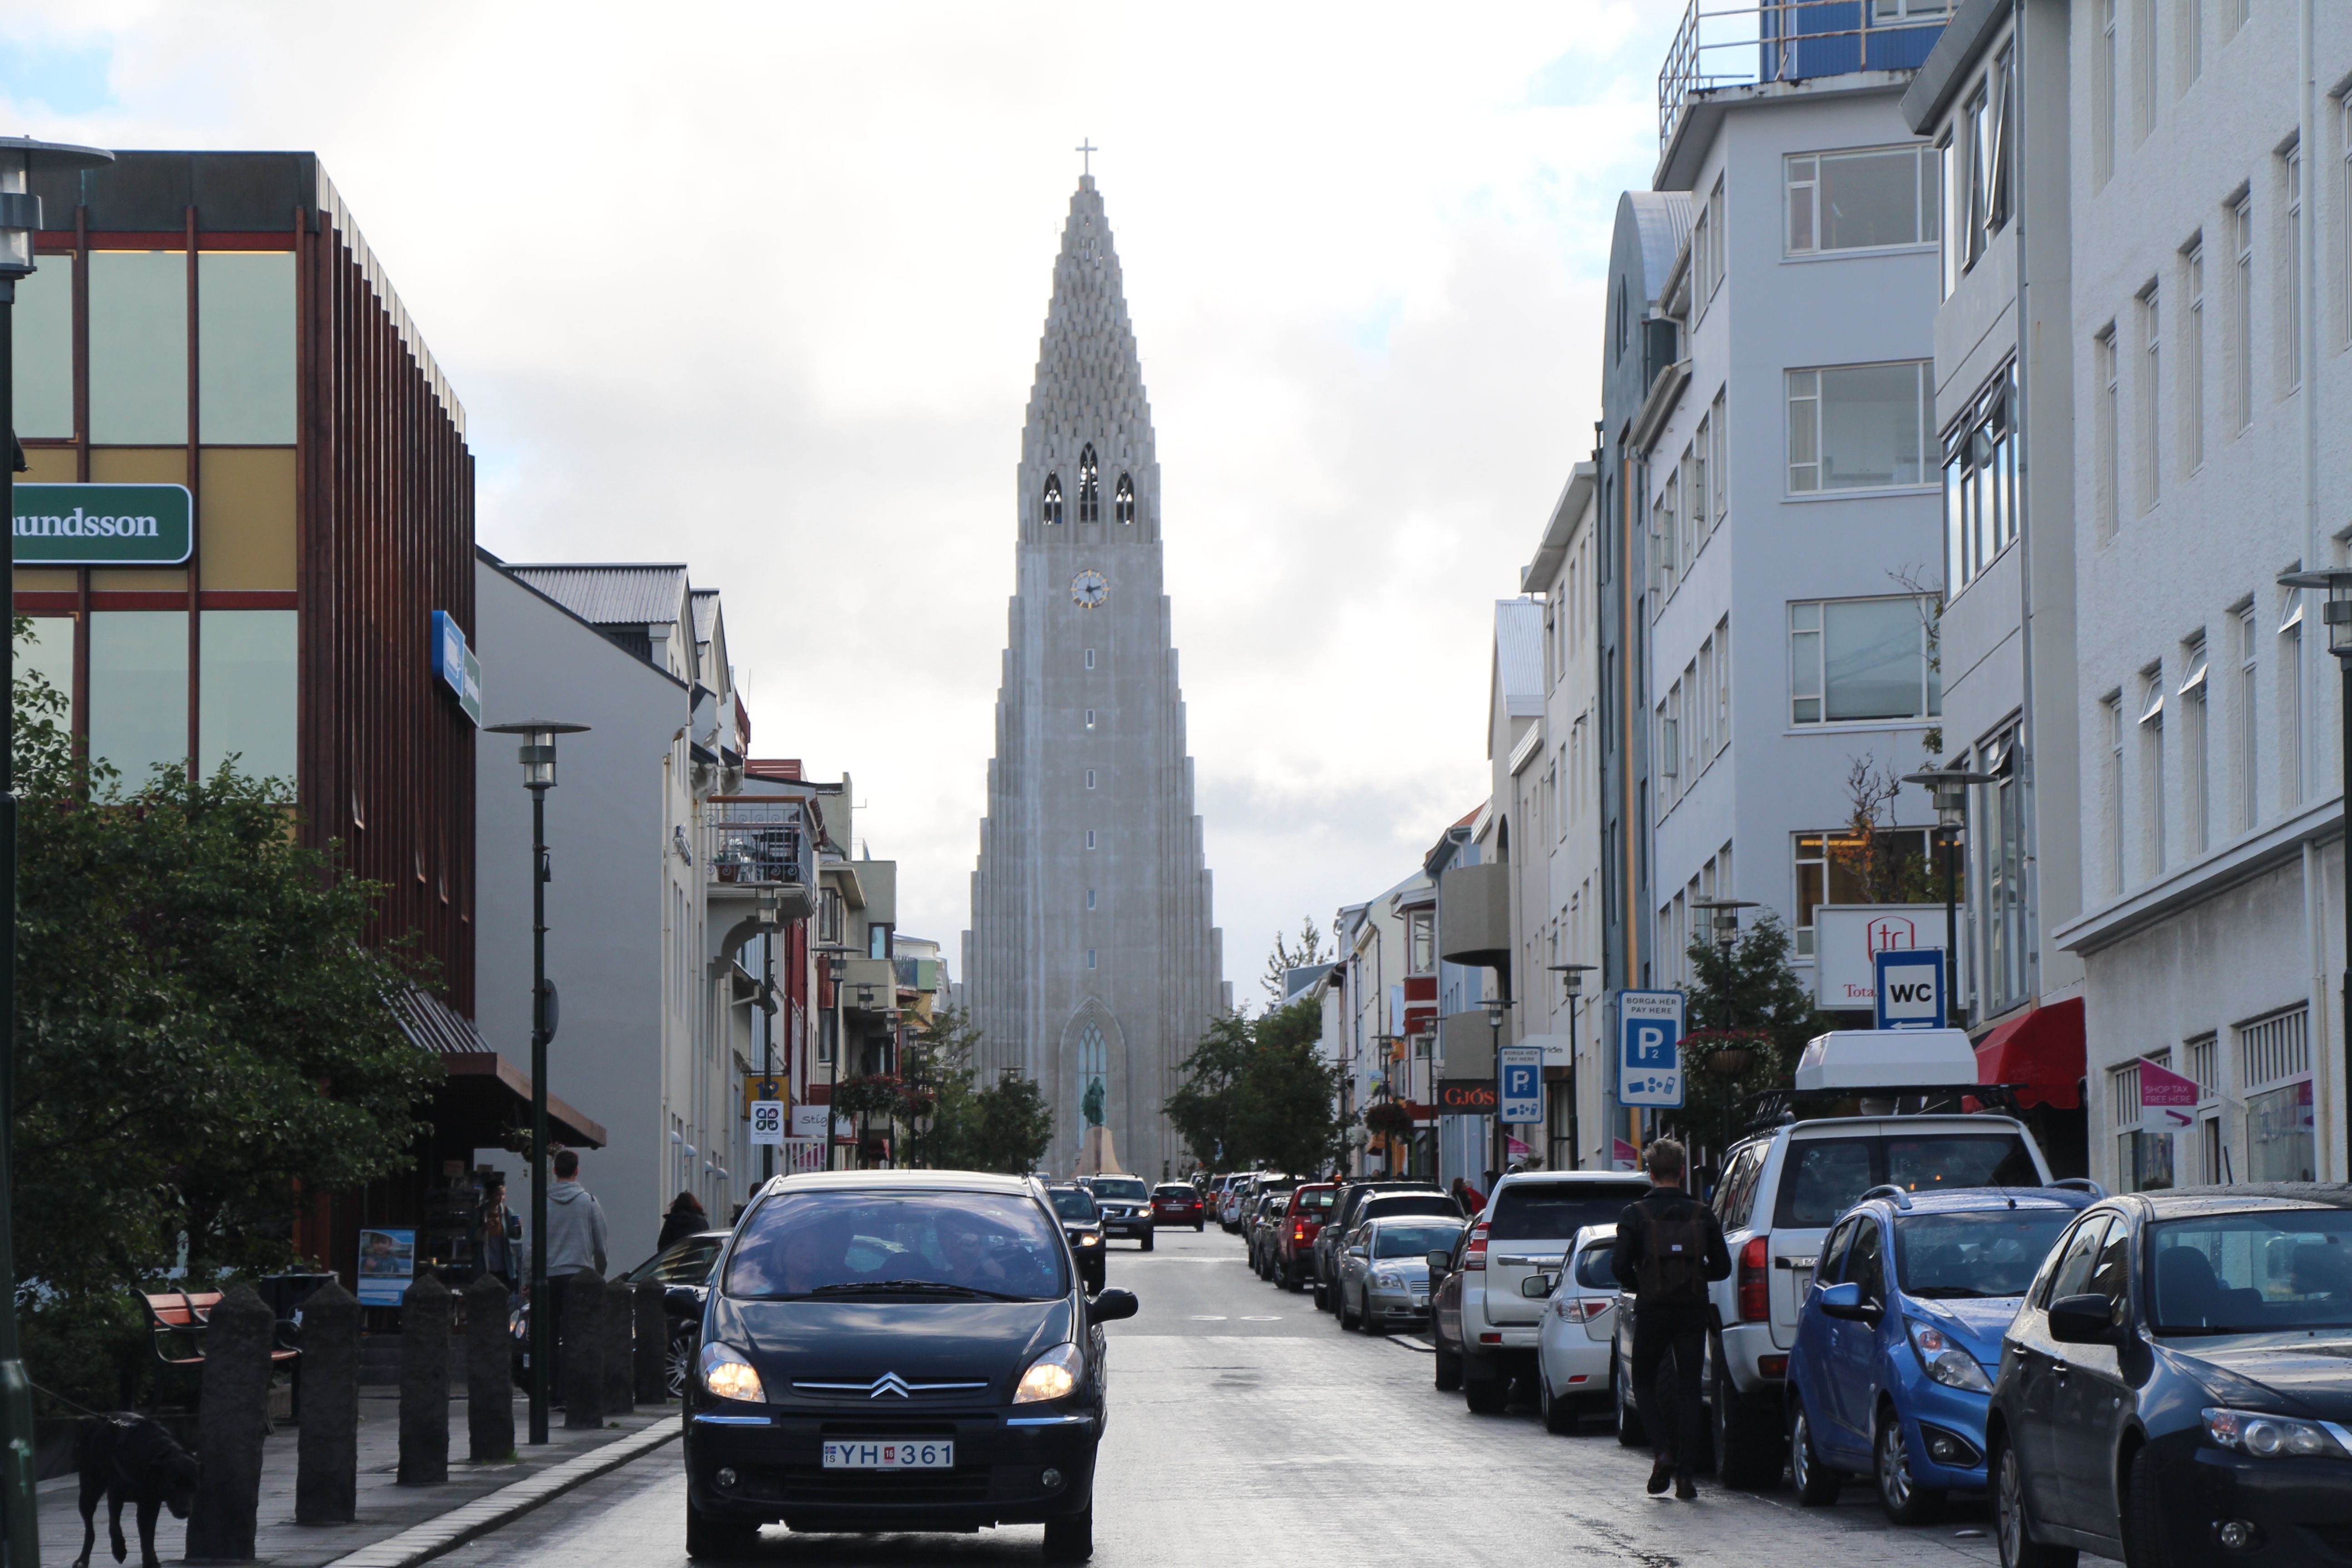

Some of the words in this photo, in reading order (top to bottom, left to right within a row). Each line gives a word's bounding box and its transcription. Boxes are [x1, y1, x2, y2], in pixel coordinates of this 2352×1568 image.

[13, 507, 159, 536] undsson
[1843, 984, 1874, 997] Tota
[1890, 984, 1932, 1003] WC
[1639, 1027, 1663, 1059] P
[1652, 1050, 1659, 1058] 2
[1513, 1071, 1529, 1093] P
[1445, 1088, 1499, 1105] GJÓS
[839, 1445, 877, 1464] YH
[901, 1445, 950, 1465] 361
